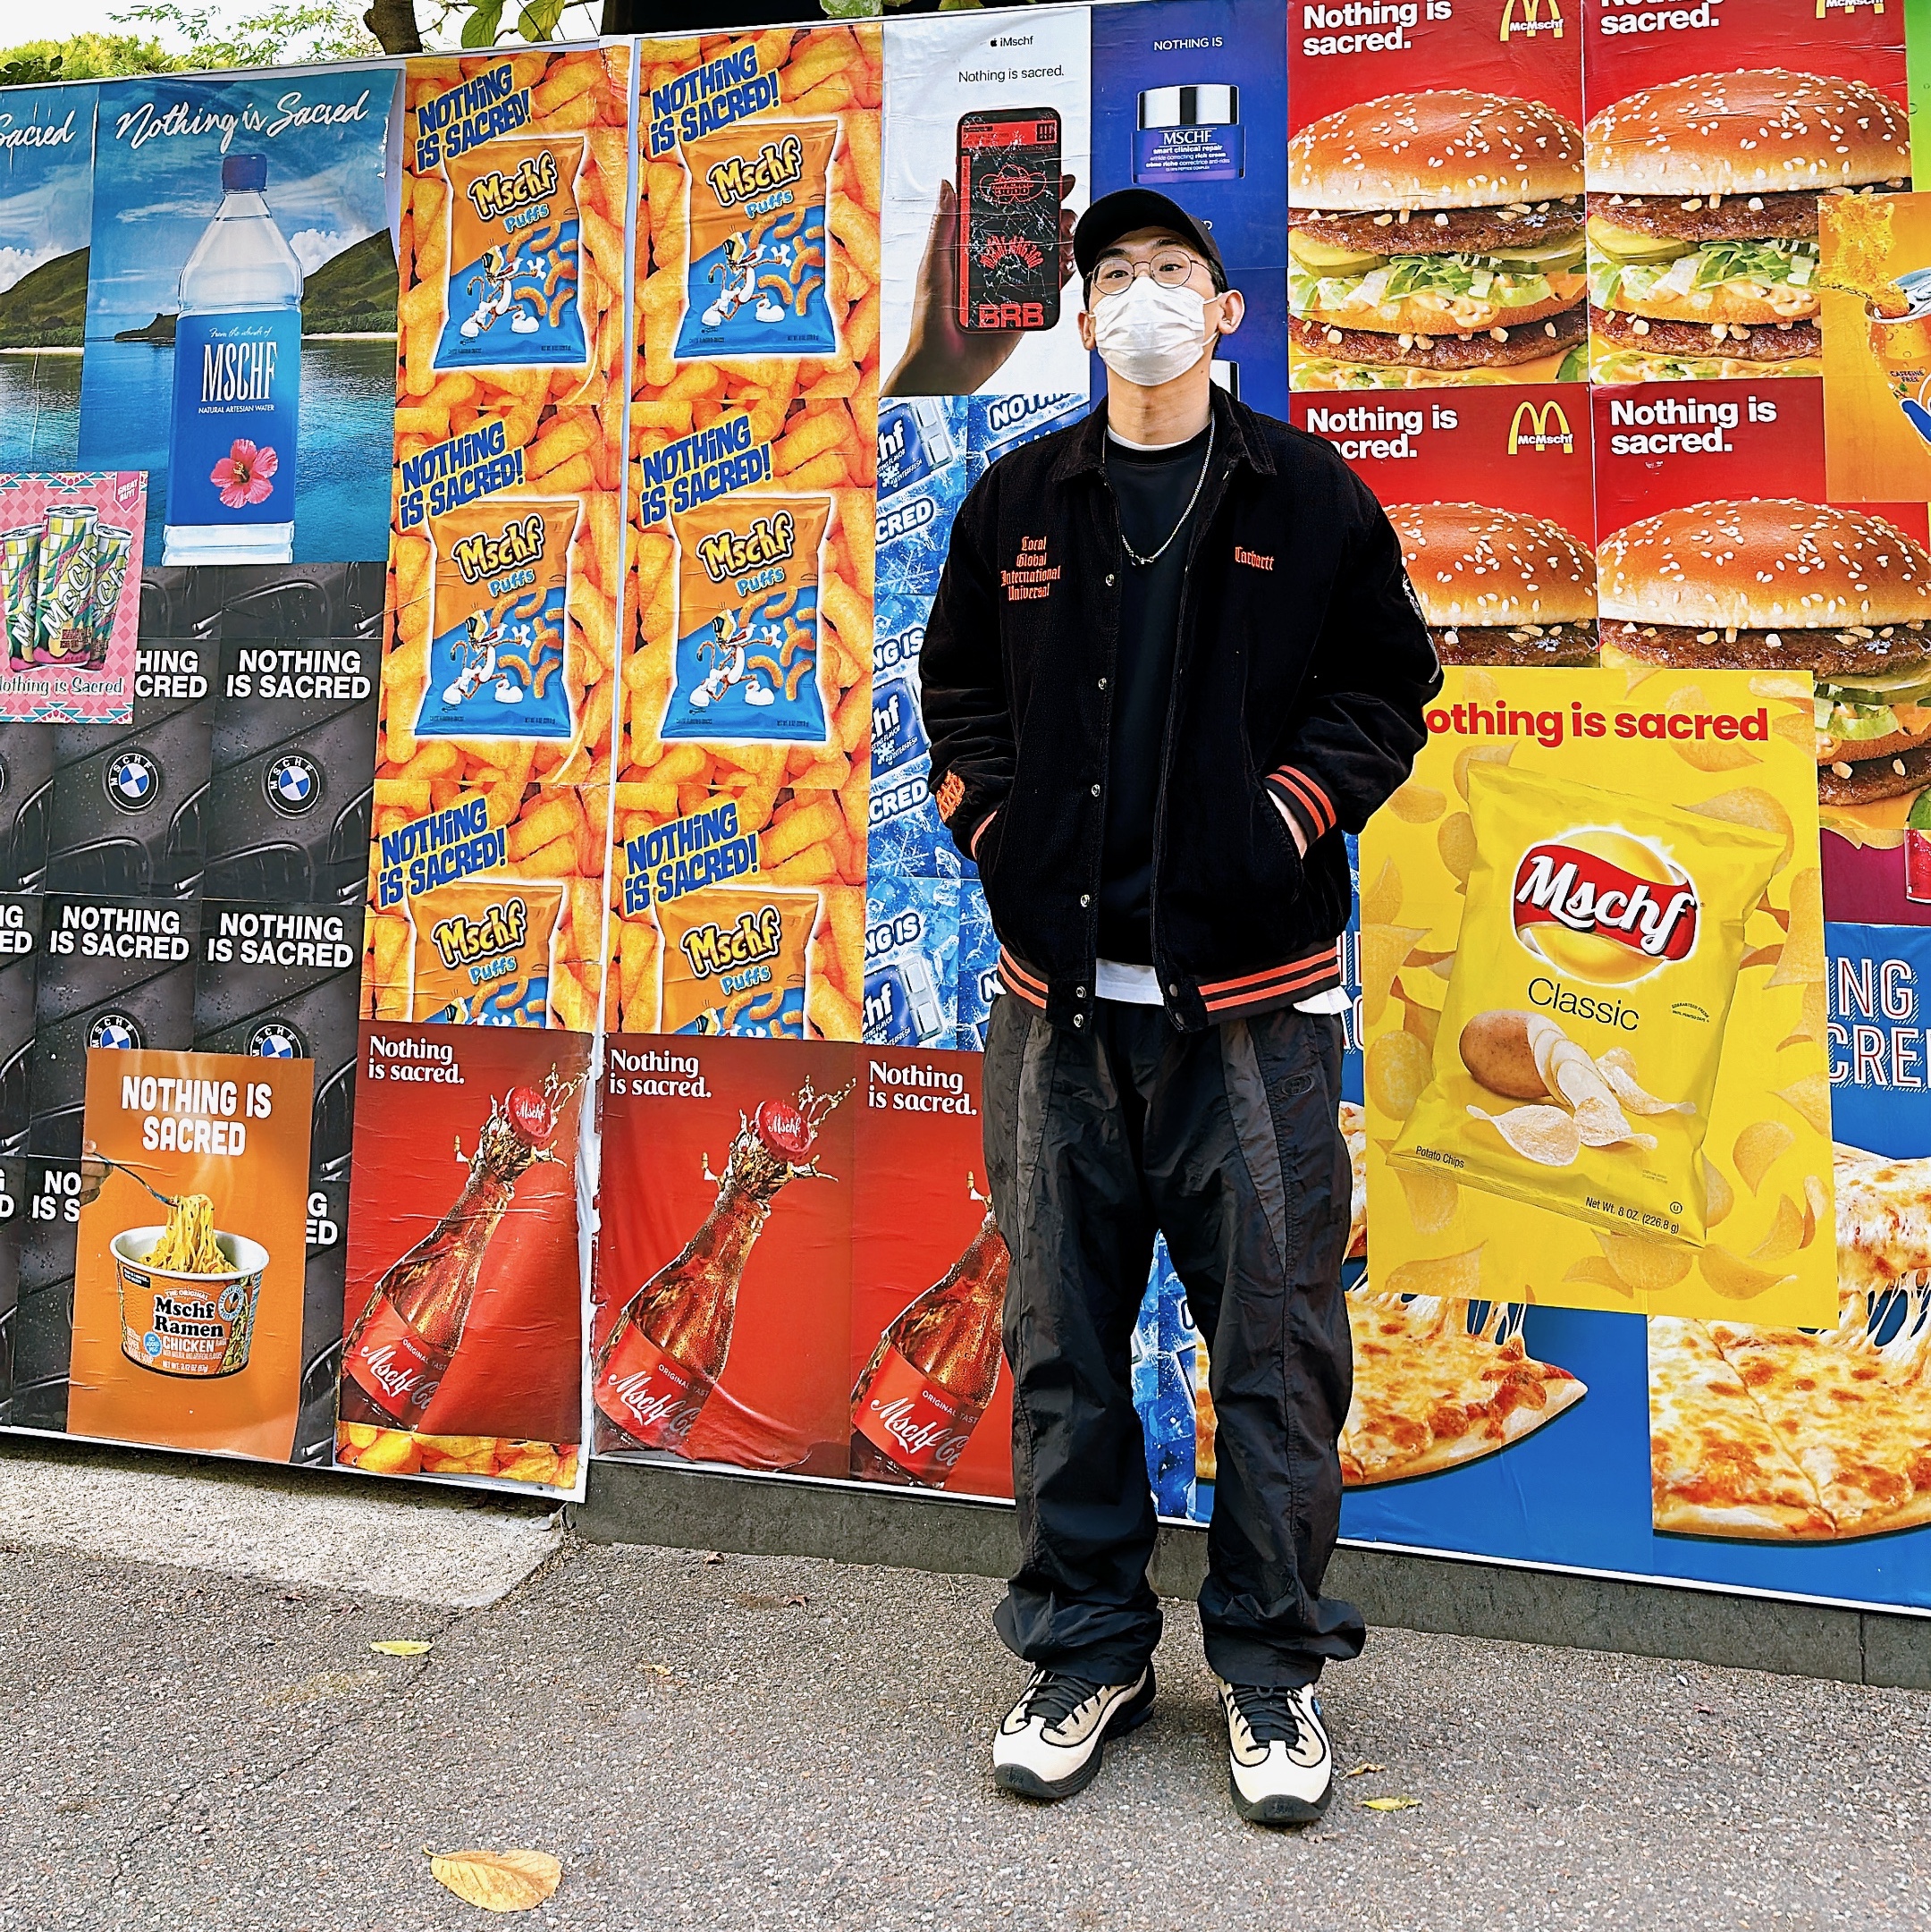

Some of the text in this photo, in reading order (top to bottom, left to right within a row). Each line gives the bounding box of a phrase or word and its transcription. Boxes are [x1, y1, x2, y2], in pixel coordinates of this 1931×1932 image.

[1303, 0, 1452, 30] Nothing is
[1509, 18, 1564, 32] McMschf
[1600, 2, 1720, 35] sacred.
[999, 36, 1033, 47] iMschf
[1153, 37, 1223, 51] NOTHING IS
[1303, 26, 1412, 56] sacred.
[958, 64, 1065, 83] Nothing is sacred.
[680, 71, 780, 142] SACRED!
[116, 90, 370, 154] Nothing is Sacred
[445, 88, 532, 159] SACRED!
[1163, 130, 1213, 145] MSCHF
[1174, 145, 1202, 154] clinical
[1202, 144, 1223, 152] repair
[468, 151, 556, 218] Mschf
[708, 137, 800, 204] Mschf
[504, 205, 548, 232] Puffs
[745, 190, 792, 218] Puffs
[979, 302, 1044, 328] BRB
[209, 327, 227, 338] From
[228, 326, 239, 337] the
[201, 342, 278, 402] MSCHF
[198, 406, 224, 414] NATURAL
[225, 405, 255, 413] ARTESIAN
[1306, 404, 1458, 435] Nothing is
[1610, 395, 1777, 428] Nothing is
[1517, 433, 1573, 445] McMschf
[1610, 426, 1733, 455] sacred.
[429, 448, 524, 517] SACRED!
[672, 443, 772, 512] SACRED!
[452, 515, 542, 579] Mschf
[698, 513, 791, 578] Mschf
[1016, 552, 1047, 568] Global
[488, 569, 535, 597] Puffs
[736, 568, 785, 596] Puffs
[1000, 564, 1061, 586] International
[1008, 582, 1050, 601] Universal
[903, 629, 925, 658] IS
[239, 649, 361, 674] NOTHING
[54, 677, 67, 695] is
[71, 674, 124, 695] Sacred
[226, 674, 371, 699] IS SACRED
[1571, 701, 1606, 738] is
[1614, 708, 1768, 741] sacred
[111, 755, 152, 787] MSCHF
[269, 757, 313, 789] MSCHF
[409, 829, 505, 896] SACRED!
[656, 833, 758, 903] SACRED!
[63, 906, 180, 933] NOTHING
[1516, 855, 1694, 956] Mschf
[220, 912, 343, 941] NOTHING
[433, 899, 525, 965] Mschf
[682, 907, 779, 974] Mschf
[895, 914, 920, 944] IS
[50, 932, 74, 954] IS
[81, 932, 190, 960] SACRED
[207, 939, 354, 967] IS SACRED
[468, 956, 516, 984] Puffs
[721, 966, 771, 994] Puffs
[1528, 977, 1640, 1031] Classic
[369, 1035, 453, 1066] Nothing
[610, 1048, 700, 1078] Nothing
[1827, 1021, 1931, 1091] CRE
[368, 1058, 465, 1084] is sacred.
[868, 1060, 965, 1096] Nothing
[122, 1075, 273, 1118] NOTHING IS
[609, 1072, 713, 1100] is sacred.
[868, 1086, 977, 1116] is sacred.
[142, 1116, 247, 1156] SACRED
[1415, 1145, 1464, 1168] Potato Chips
[31, 1194, 56, 1220] IS
[1585, 1196, 1679, 1235] Net Wt. 8 OZ. (226.8 g)
[155, 1295, 215, 1319] Mschf
[154, 1314, 223, 1337] Ramen
[162, 1336, 215, 1353] CHICKEN
[402, 1338, 430, 1364] ORIGINAL
[360, 1345, 426, 1397] Mschf
[658, 1364, 690, 1390] ORIGINAL
[608, 1371, 687, 1426] Mschf
[922, 1390, 957, 1417] ORIGINAL
[871, 1396, 953, 1455] Mschf
